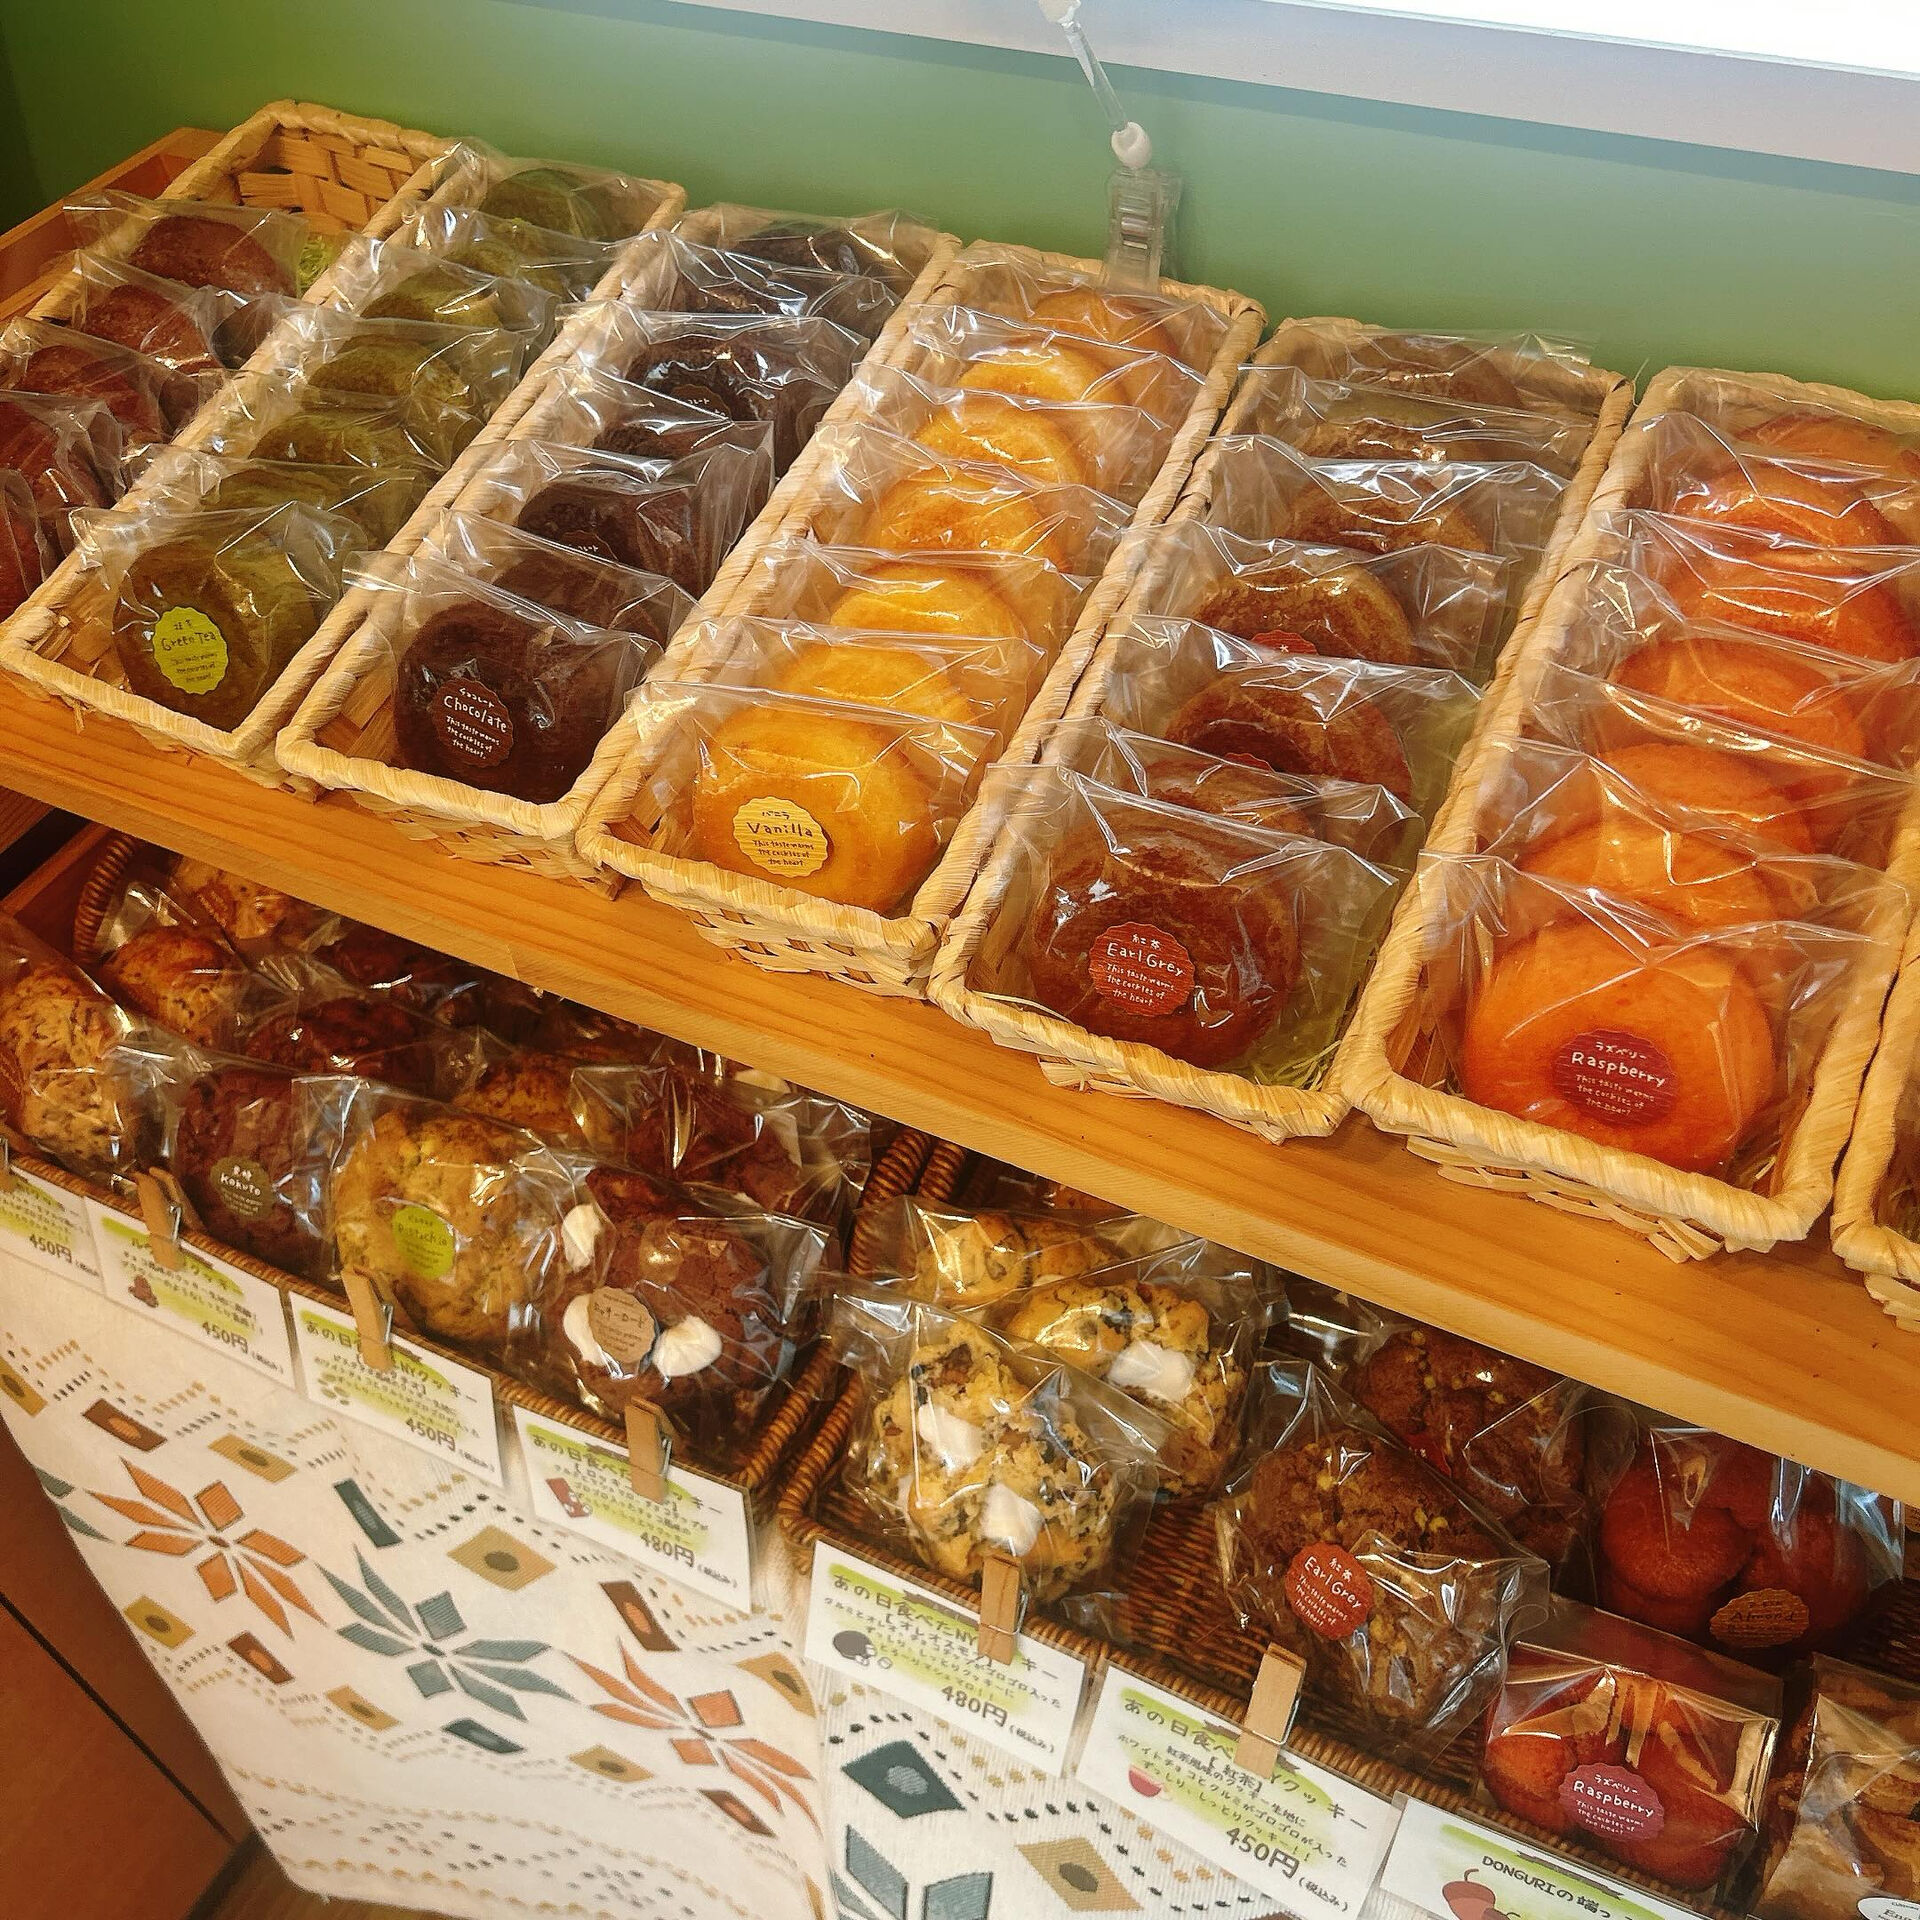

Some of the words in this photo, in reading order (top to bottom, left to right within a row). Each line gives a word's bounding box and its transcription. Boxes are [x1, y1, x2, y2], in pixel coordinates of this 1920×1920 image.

[161, 636, 194, 651] Green
[194, 632, 216, 644] Tea
[444, 695, 506, 733] Chocolate
[459, 687, 494, 708] チョコレート
[746, 821, 813, 837] Vanilla
[1107, 942, 1142, 962] Earl
[1146, 953, 1184, 976] Grey
[1132, 933, 1161, 949] 紅茶
[1595, 1041, 1647, 1059] ラズベリー
[1571, 1051, 1666, 1087] Raspberry
[29, 1233, 72, 1264] 450円
[201, 1321, 248, 1355] 450円
[406, 1417, 456, 1451] 450円
[640, 1531, 695, 1568] 480円
[1304, 1556, 1333, 1585] Earl
[1331, 1581, 1361, 1608] Grey
[1329, 1556, 1352, 1583] 紅茶
[833, 1572, 1059, 1680] あの日食べたNYキー
[941, 1684, 1008, 1727] 480円
[1124, 1697, 1368, 1830] あの日食べYクッキー
[1209, 1756, 1263, 1793] 【紅茶】
[1166, 1744, 1306, 1828] 紅茶風味のクッキー生地に
[1573, 1780, 1654, 1818] Raspberry
[1594, 1773, 1638, 1794] ラズベリー
[1226, 1827, 1301, 1880] 450円
[1482, 1855, 1633, 1920] DONGURIの端っ
